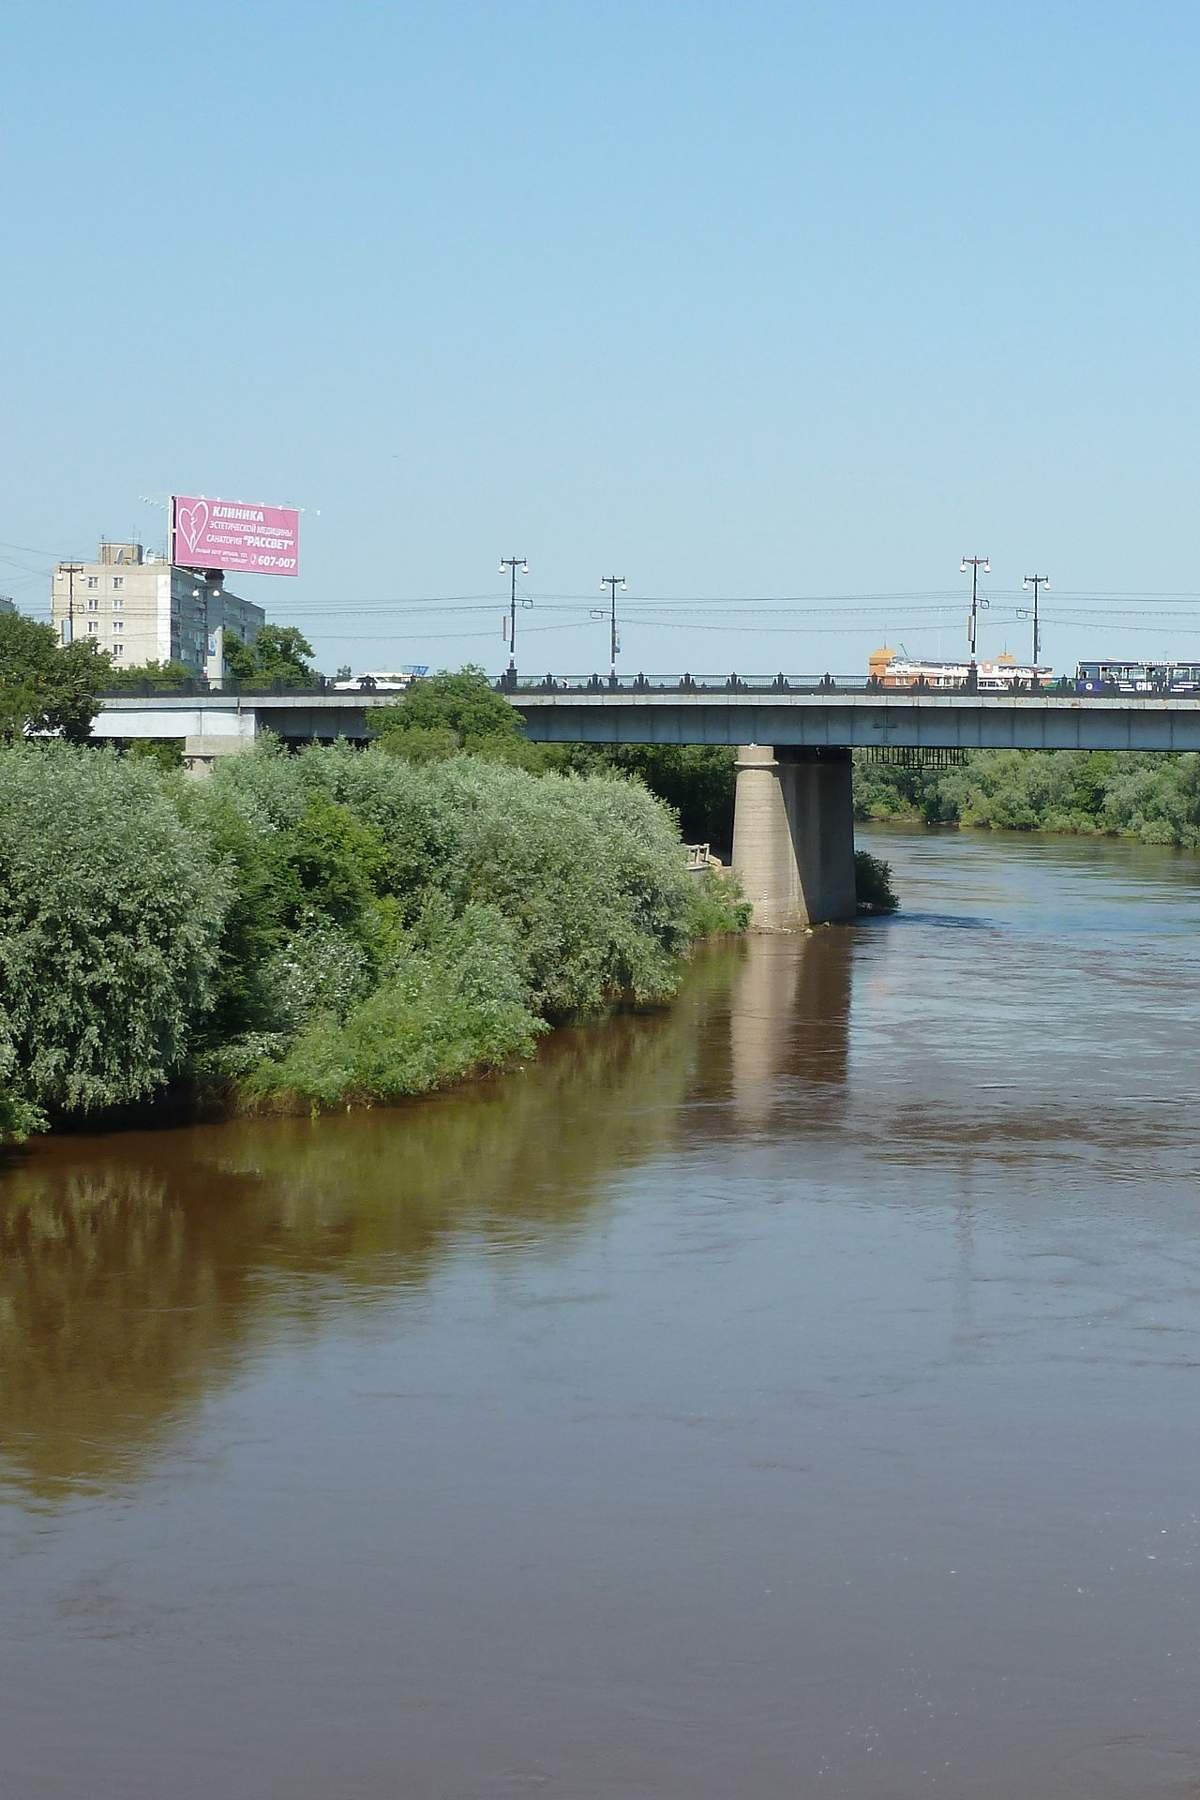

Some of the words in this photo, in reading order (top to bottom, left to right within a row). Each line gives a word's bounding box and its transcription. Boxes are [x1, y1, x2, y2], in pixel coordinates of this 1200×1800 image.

[213, 507, 264, 522] КЛИНИКА
[209, 521, 256, 533] ЭСТЕТИЧЕСКОЙ
[243, 536, 294, 549] "РАССВЕТ"
[258, 555, 296, 568] 607-007
